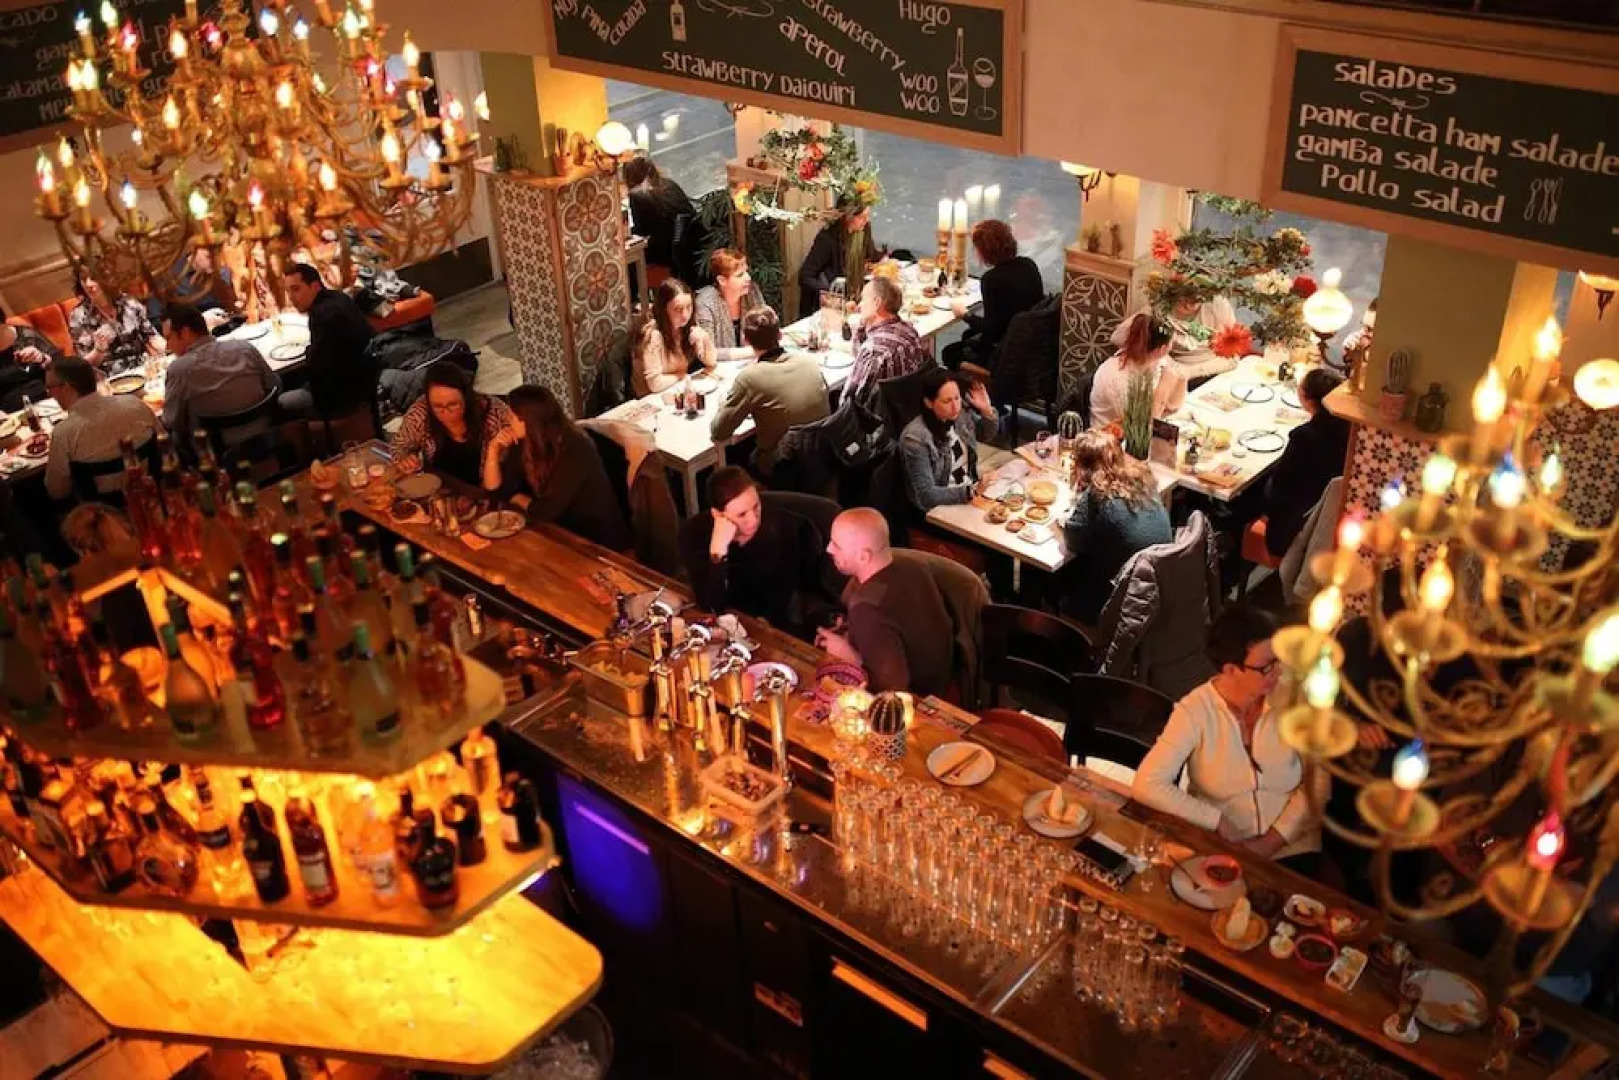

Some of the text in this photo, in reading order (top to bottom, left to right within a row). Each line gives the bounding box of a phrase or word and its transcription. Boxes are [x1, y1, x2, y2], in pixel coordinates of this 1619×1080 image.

[1393, 146, 1500, 189] salade
[1508, 133, 1619, 176] salade
[1320, 163, 1506, 224] Pollo salad
